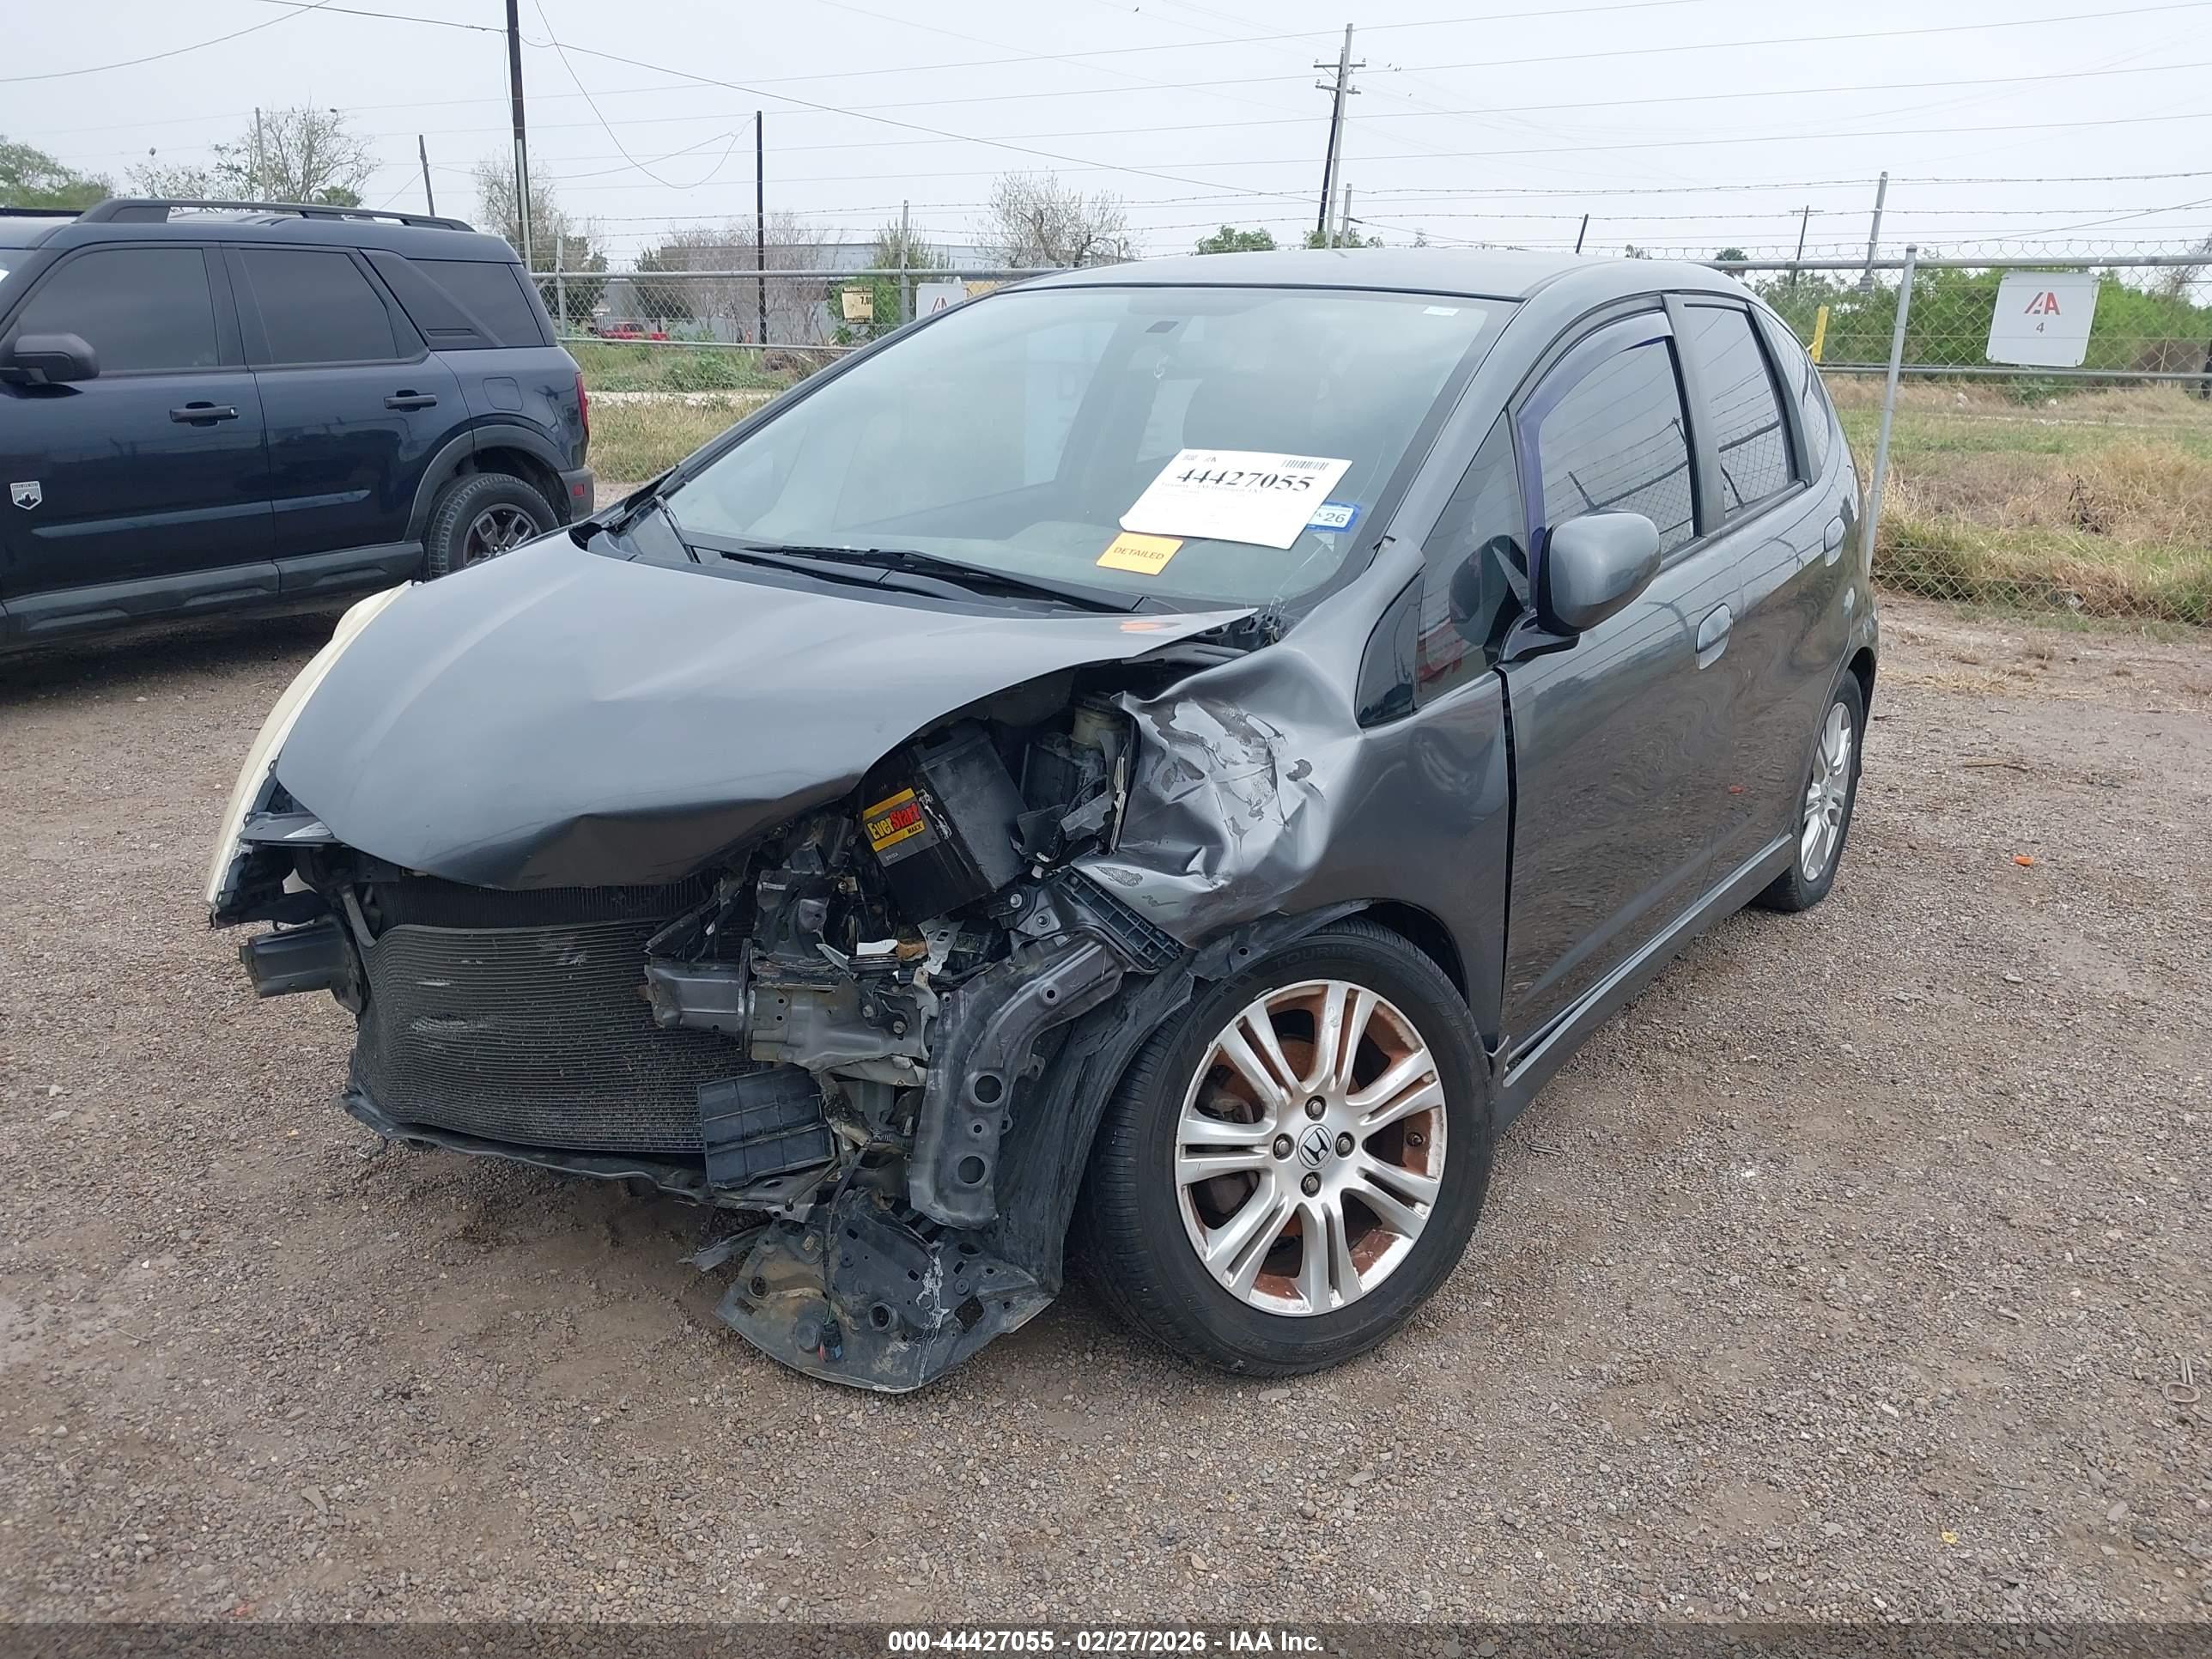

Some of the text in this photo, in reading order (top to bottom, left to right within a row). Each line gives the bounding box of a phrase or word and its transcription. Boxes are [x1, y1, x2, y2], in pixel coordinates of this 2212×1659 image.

[2036, 322, 2045, 333] 4
[1176, 468, 1317, 492] 44427055
[1323, 513, 1346, 523] 26
[1113, 545, 1165, 561] DETAILED
[867, 802, 921, 840] EverStart
[906, 823, 923, 835] MAXX
